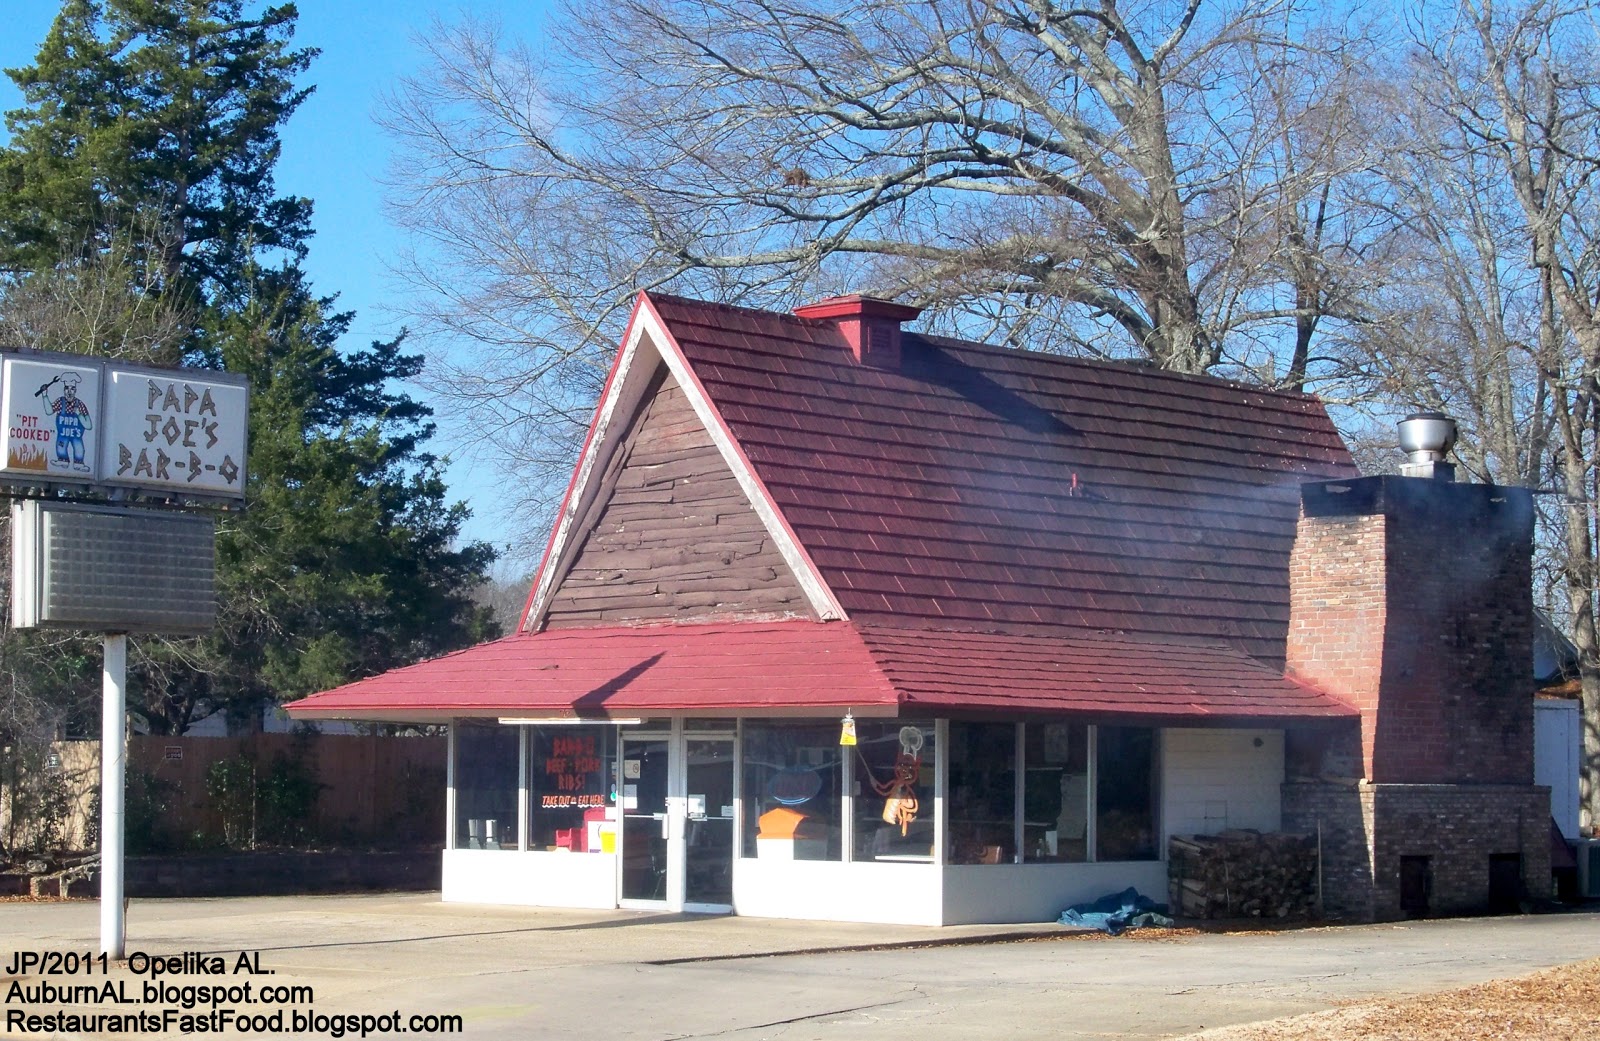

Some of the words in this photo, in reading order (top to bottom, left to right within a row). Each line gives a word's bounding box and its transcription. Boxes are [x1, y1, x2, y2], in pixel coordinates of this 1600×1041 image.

[147, 379, 217, 417] PAPA
[59, 416, 79, 426] PAPA
[143, 414, 219, 449] JOE'S
[60, 428, 81, 437] JOE'S
[117, 443, 239, 484] BAR-B-Q
[542, 796, 558, 805] TAKE
[559, 796, 570, 805] OUT
[578, 795, 589, 805] EAT
[590, 795, 605, 804] HERE
